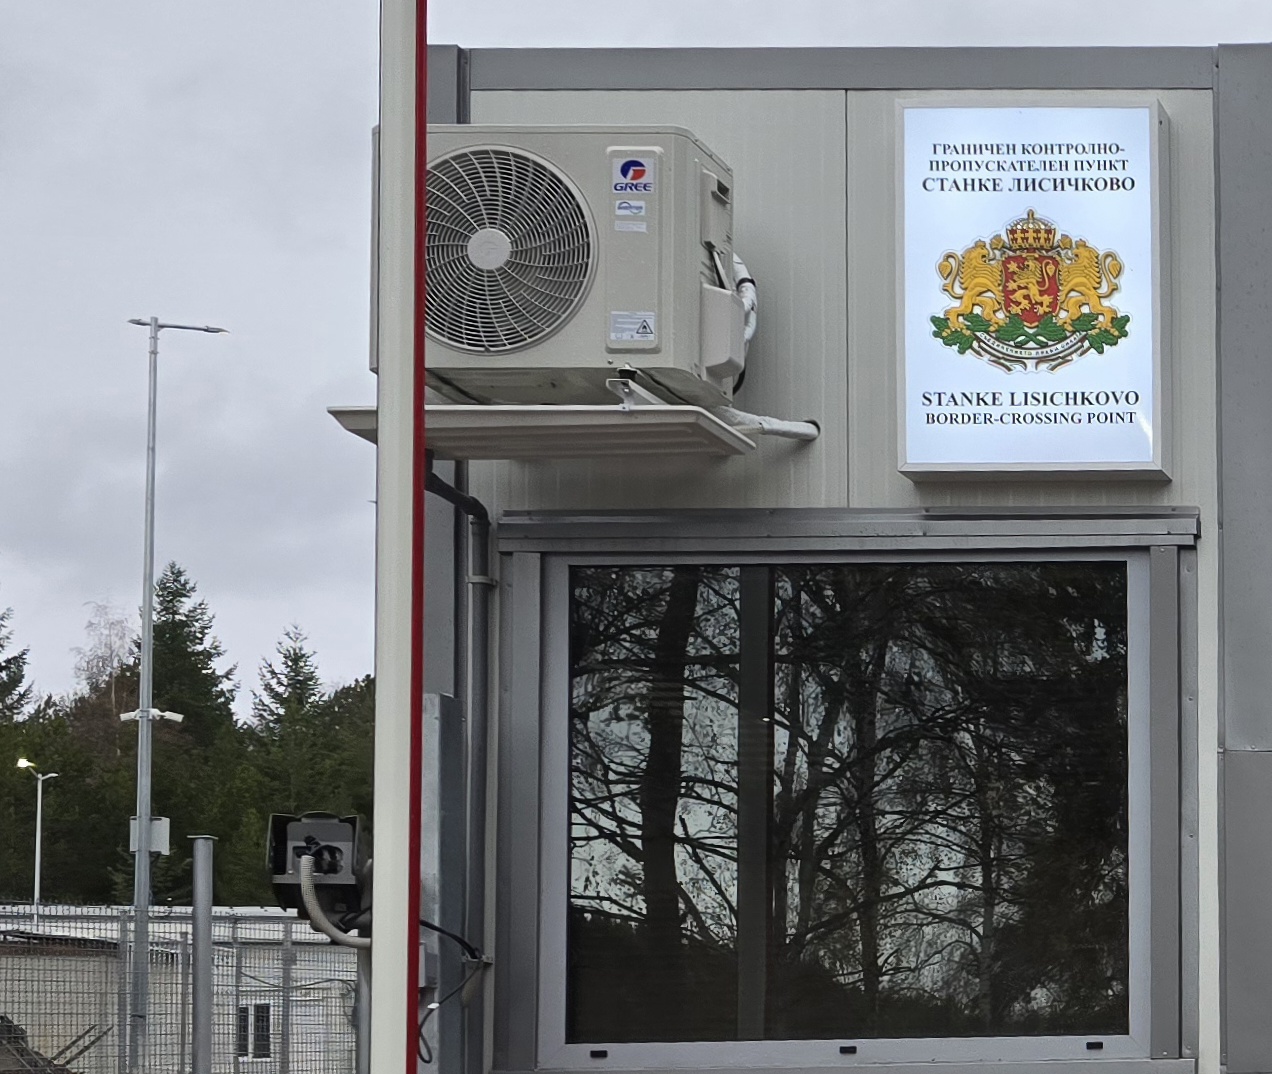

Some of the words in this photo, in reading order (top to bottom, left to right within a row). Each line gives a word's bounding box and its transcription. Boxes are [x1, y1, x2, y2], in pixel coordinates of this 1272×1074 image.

[932, 143, 1016, 155] ГРАНИЧЕН
[1021, 143, 1126, 155] КОНТРОЛНО-
[929, 160, 1069, 172] ПРОПУСКАТЕЛЕН
[1074, 159, 1129, 172] ПУНКТ
[613, 182, 653, 192] GREE
[922, 177, 1003, 192] СТАНКЕ
[1008, 177, 1136, 192] ЛИСИЧКОВО
[921, 391, 1003, 407] STANKE
[1009, 390, 1140, 407] LISICHKOVO
[925, 412, 1082, 425] BORDER-CROSSING
[1087, 411, 1137, 424] POINT
